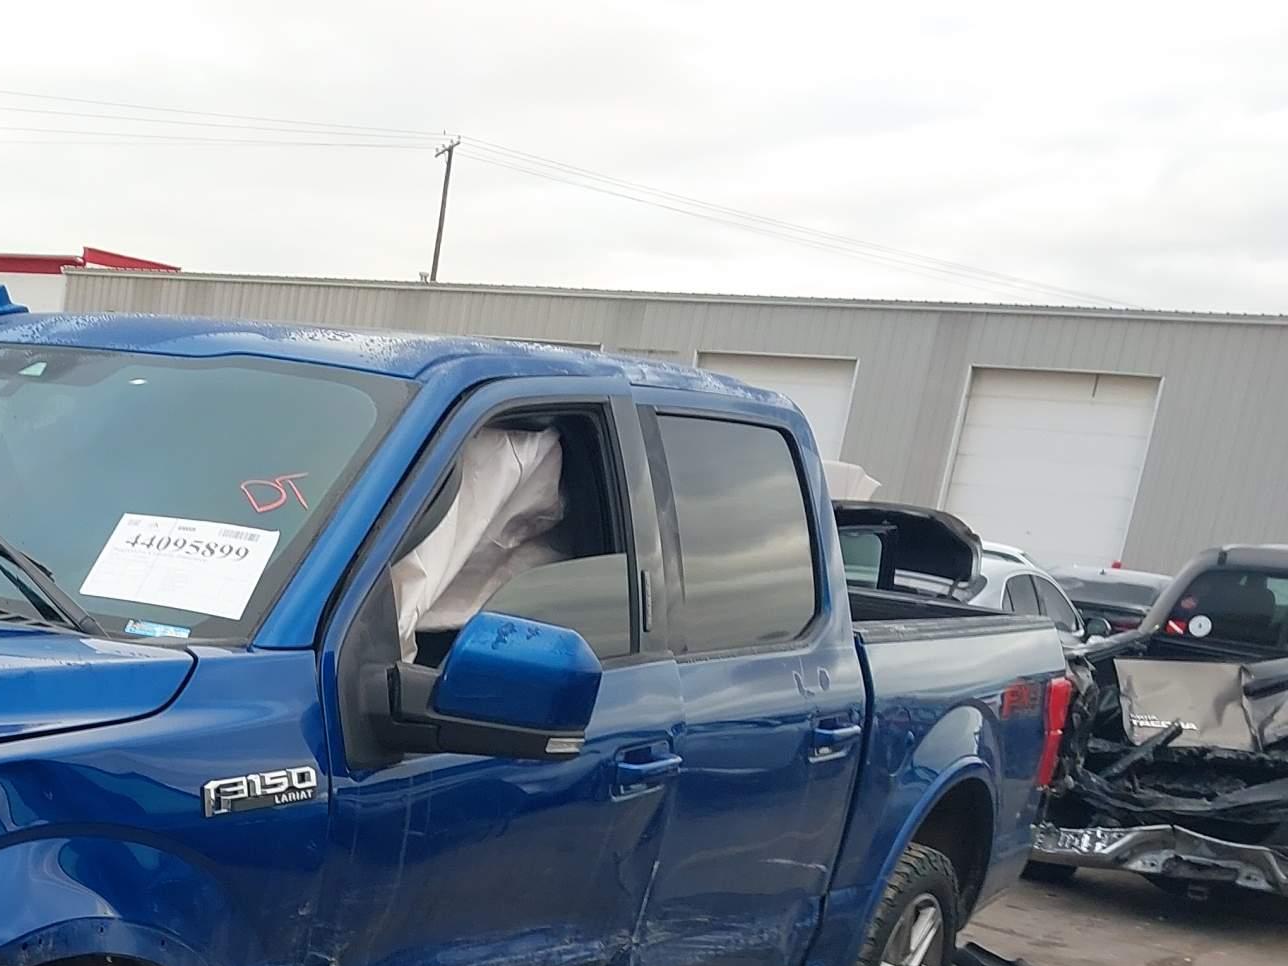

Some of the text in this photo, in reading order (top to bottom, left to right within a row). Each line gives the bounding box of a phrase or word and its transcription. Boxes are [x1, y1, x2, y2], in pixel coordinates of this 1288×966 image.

[241, 472, 309, 512] DT
[125, 533, 250, 562] 44095899
[274, 790, 314, 804] LARIAT
